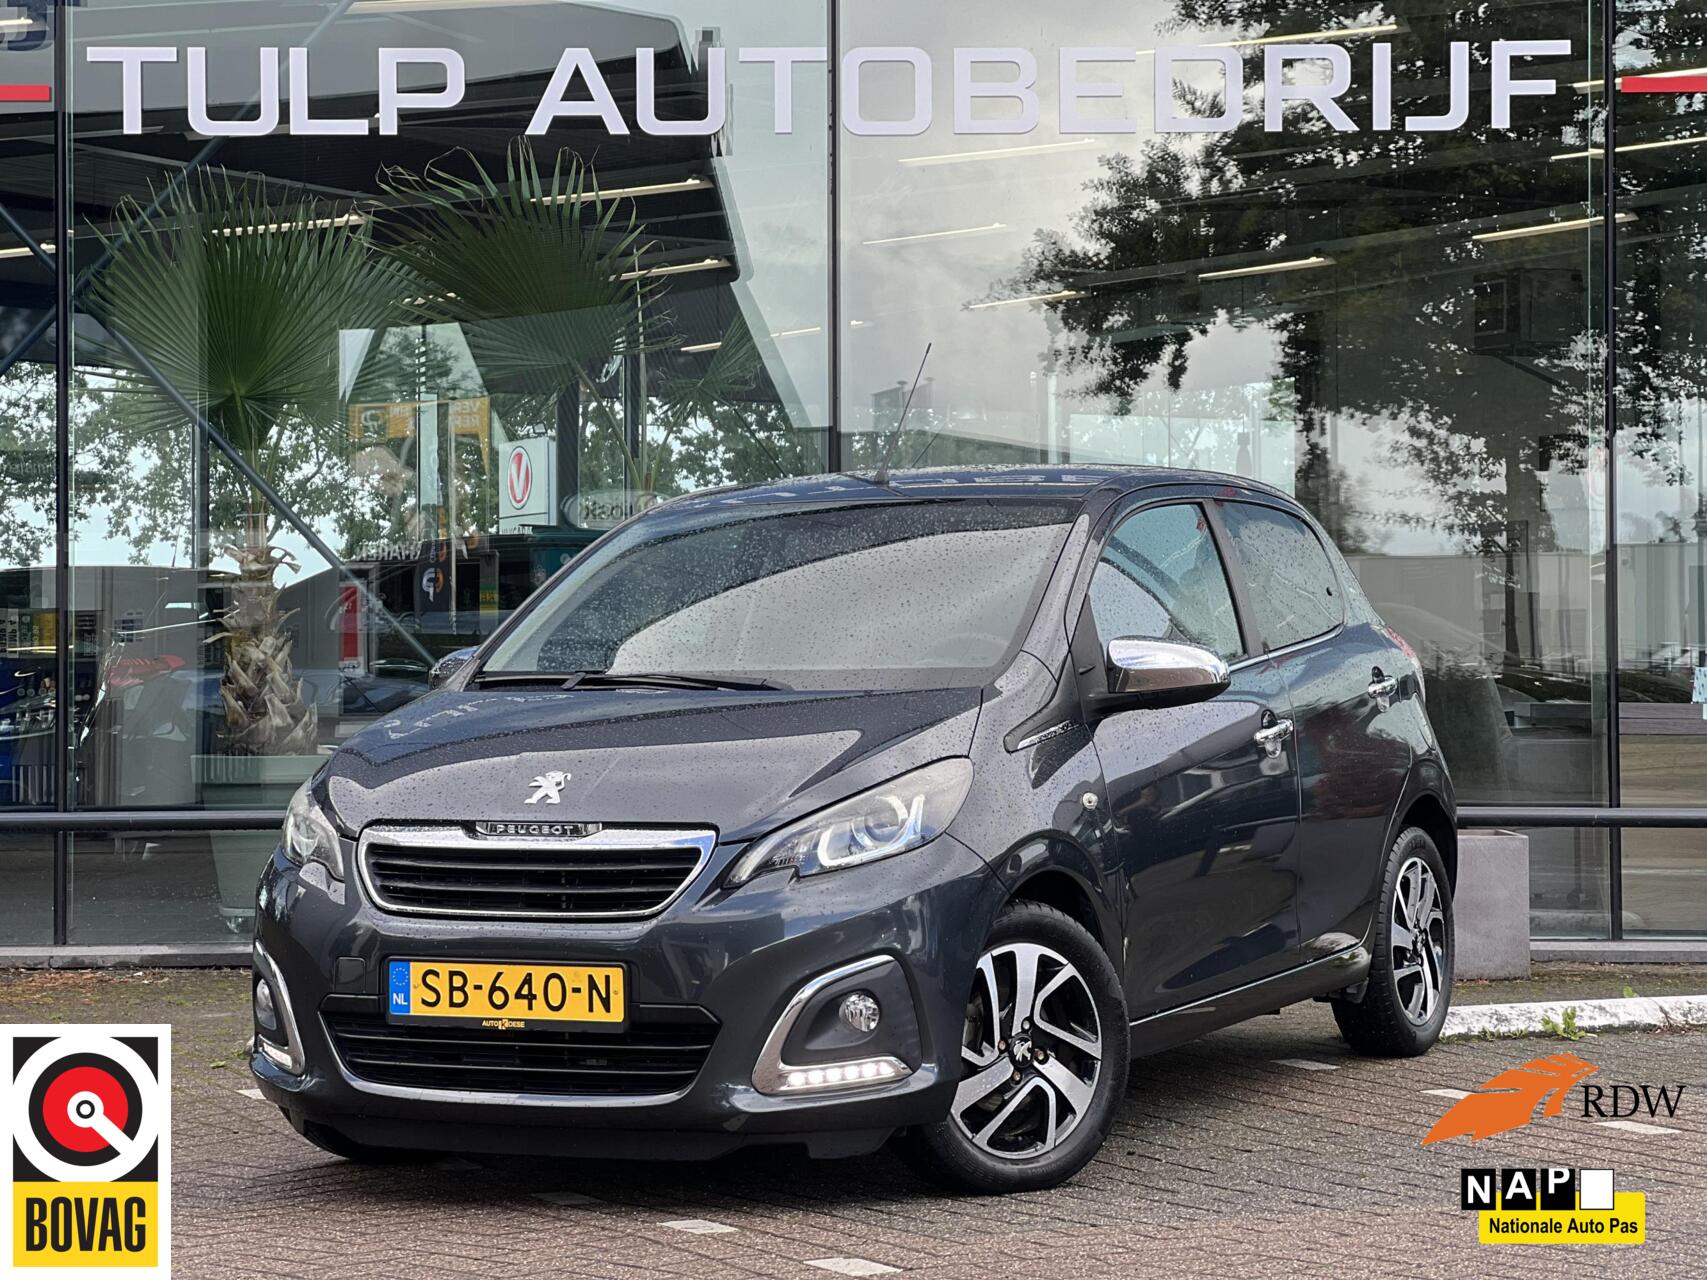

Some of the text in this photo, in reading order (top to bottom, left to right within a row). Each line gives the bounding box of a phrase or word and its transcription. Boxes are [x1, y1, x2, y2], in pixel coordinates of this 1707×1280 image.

[87, 40, 1571, 136] TULP AUTOBEDRIJF
[496, 824, 573, 836] PEUGEOT
[392, 993, 408, 1005] NL
[420, 969, 611, 1013] SB-640-N
